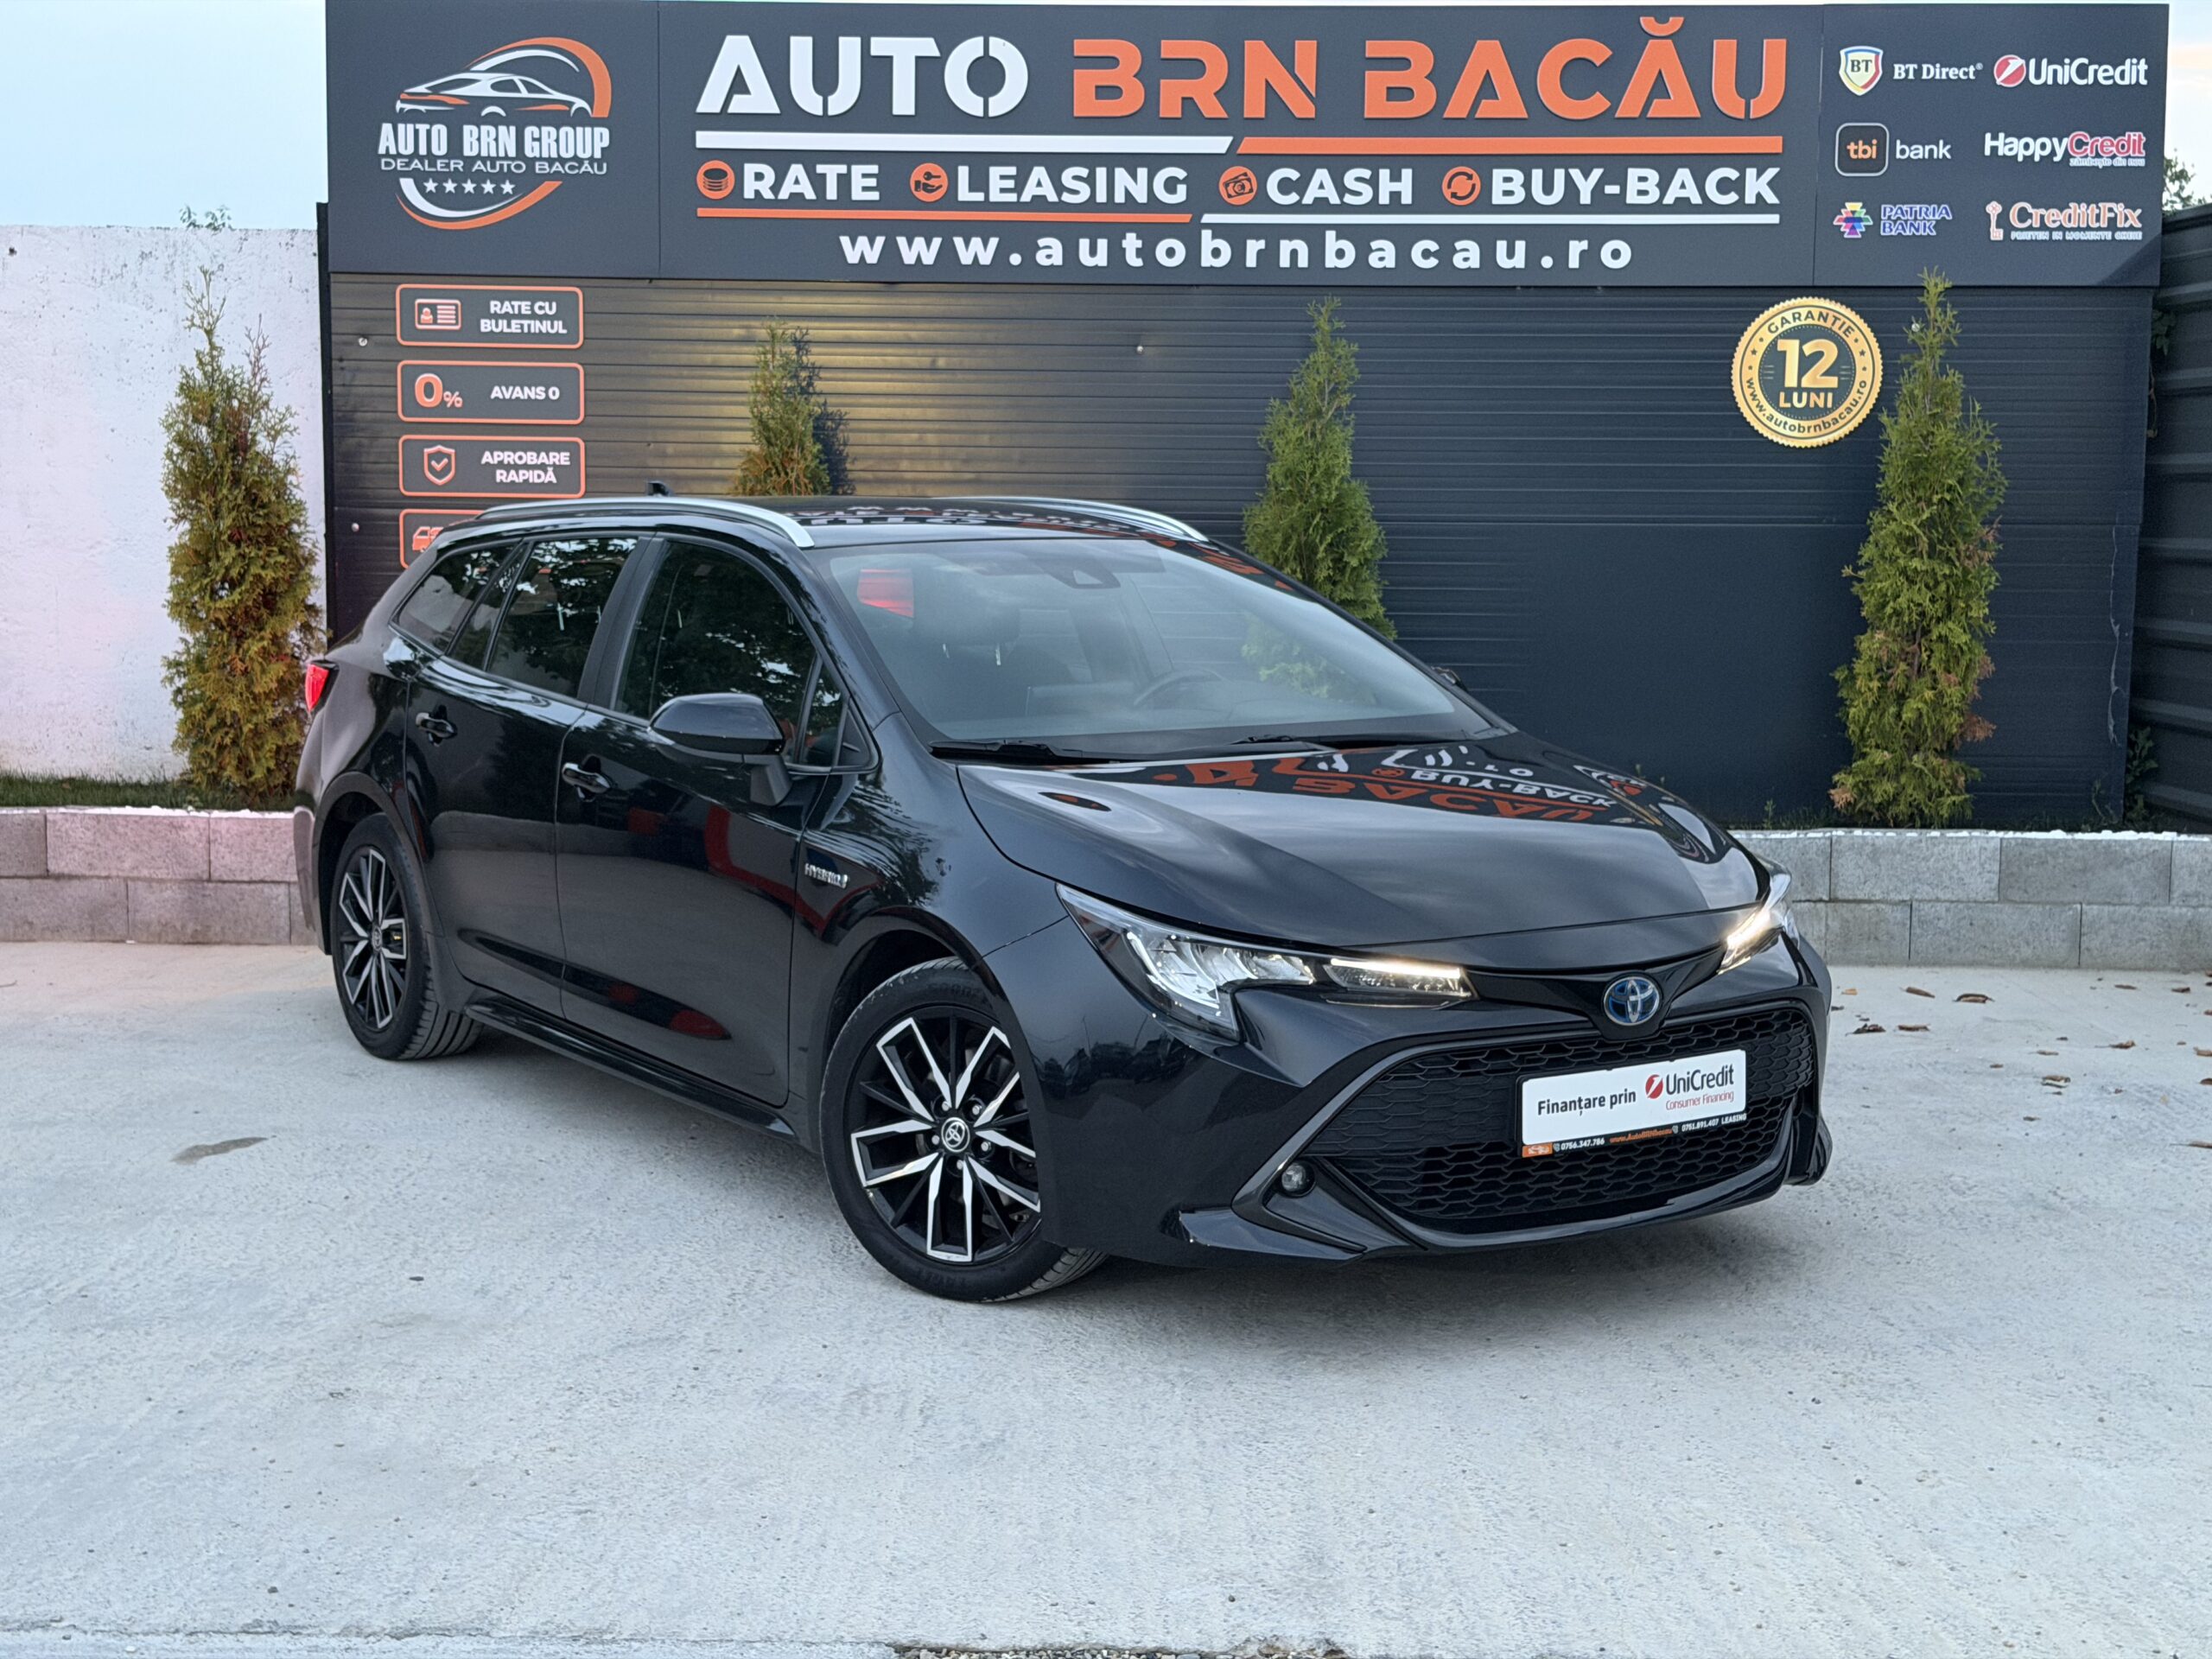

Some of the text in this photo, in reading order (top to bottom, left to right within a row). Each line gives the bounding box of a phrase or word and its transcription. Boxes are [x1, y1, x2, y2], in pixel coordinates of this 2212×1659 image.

[695, 16, 1787, 122] AUTO BRN BACĂU
[1849, 57, 1873, 74] BT
[1892, 62, 1917, 81] BT
[2028, 56, 2149, 86] UniCredit
[377, 122, 610, 159] AUTO BRN GROUP
[1846, 138, 1952, 160] tbi bank
[1983, 130, 2146, 162] HappyCredit
[380, 157, 607, 175] DEALER AUTO BACĂU
[743, 162, 1781, 206] RATE LEASING CASH BUY-BACK
[1881, 205, 1952, 220] PATRIA
[2010, 201, 2142, 228] CreditFix
[1880, 219, 1936, 236] BANK
[838, 228, 1632, 270] www.autobrnbacau.ro
[489, 300, 556, 315] RATE CU
[480, 319, 567, 334] BULETINUL
[1767, 309, 1855, 339] GARANTIE
[1777, 338, 1838, 388] 12
[490, 385, 560, 400] AVANS 0
[1778, 391, 1834, 409] LUNI
[1745, 377, 1867, 434] www.autobrnbacau.ro
[480, 451, 571, 466] APROBARE
[495, 467, 557, 483] RAPIDĂ
[1665, 1064, 1735, 1096] UniCredit
[1537, 1087, 1637, 1116] Finanțare prin
[1665, 1090, 1734, 1110] Consumer Financing
[1720, 1112, 1747, 1125] LEASING
